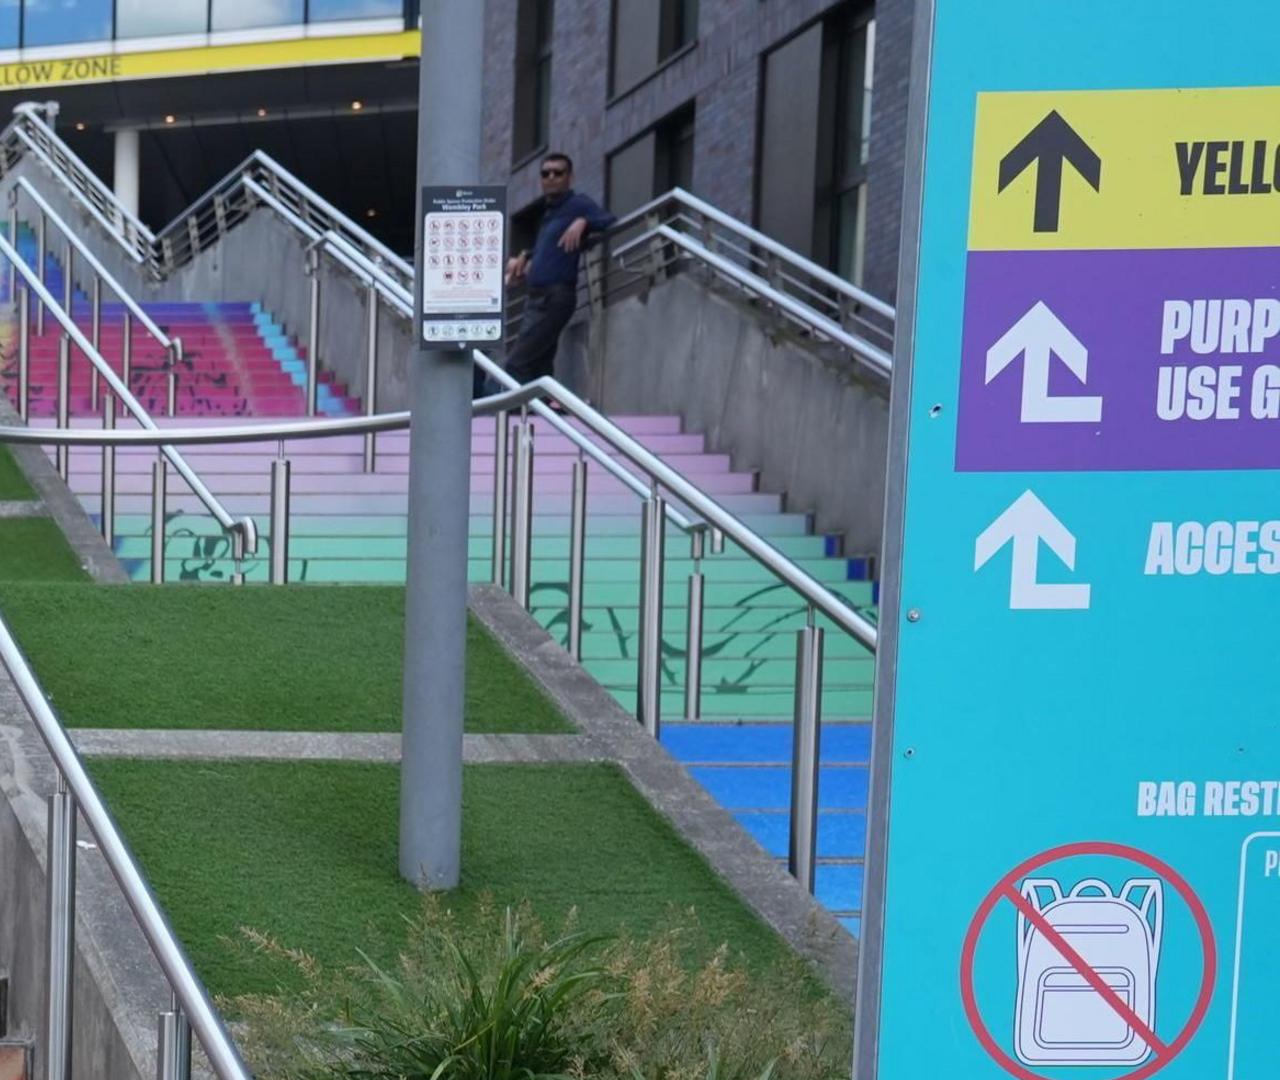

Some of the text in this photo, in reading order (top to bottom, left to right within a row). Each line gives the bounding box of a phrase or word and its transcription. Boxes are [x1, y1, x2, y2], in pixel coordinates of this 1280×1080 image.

[60, 56, 122, 81] ZONE
[1160, 299, 1280, 354] PURP
[1157, 365, 1242, 421] USE
[1137, 781, 1280, 817] BAG REST
